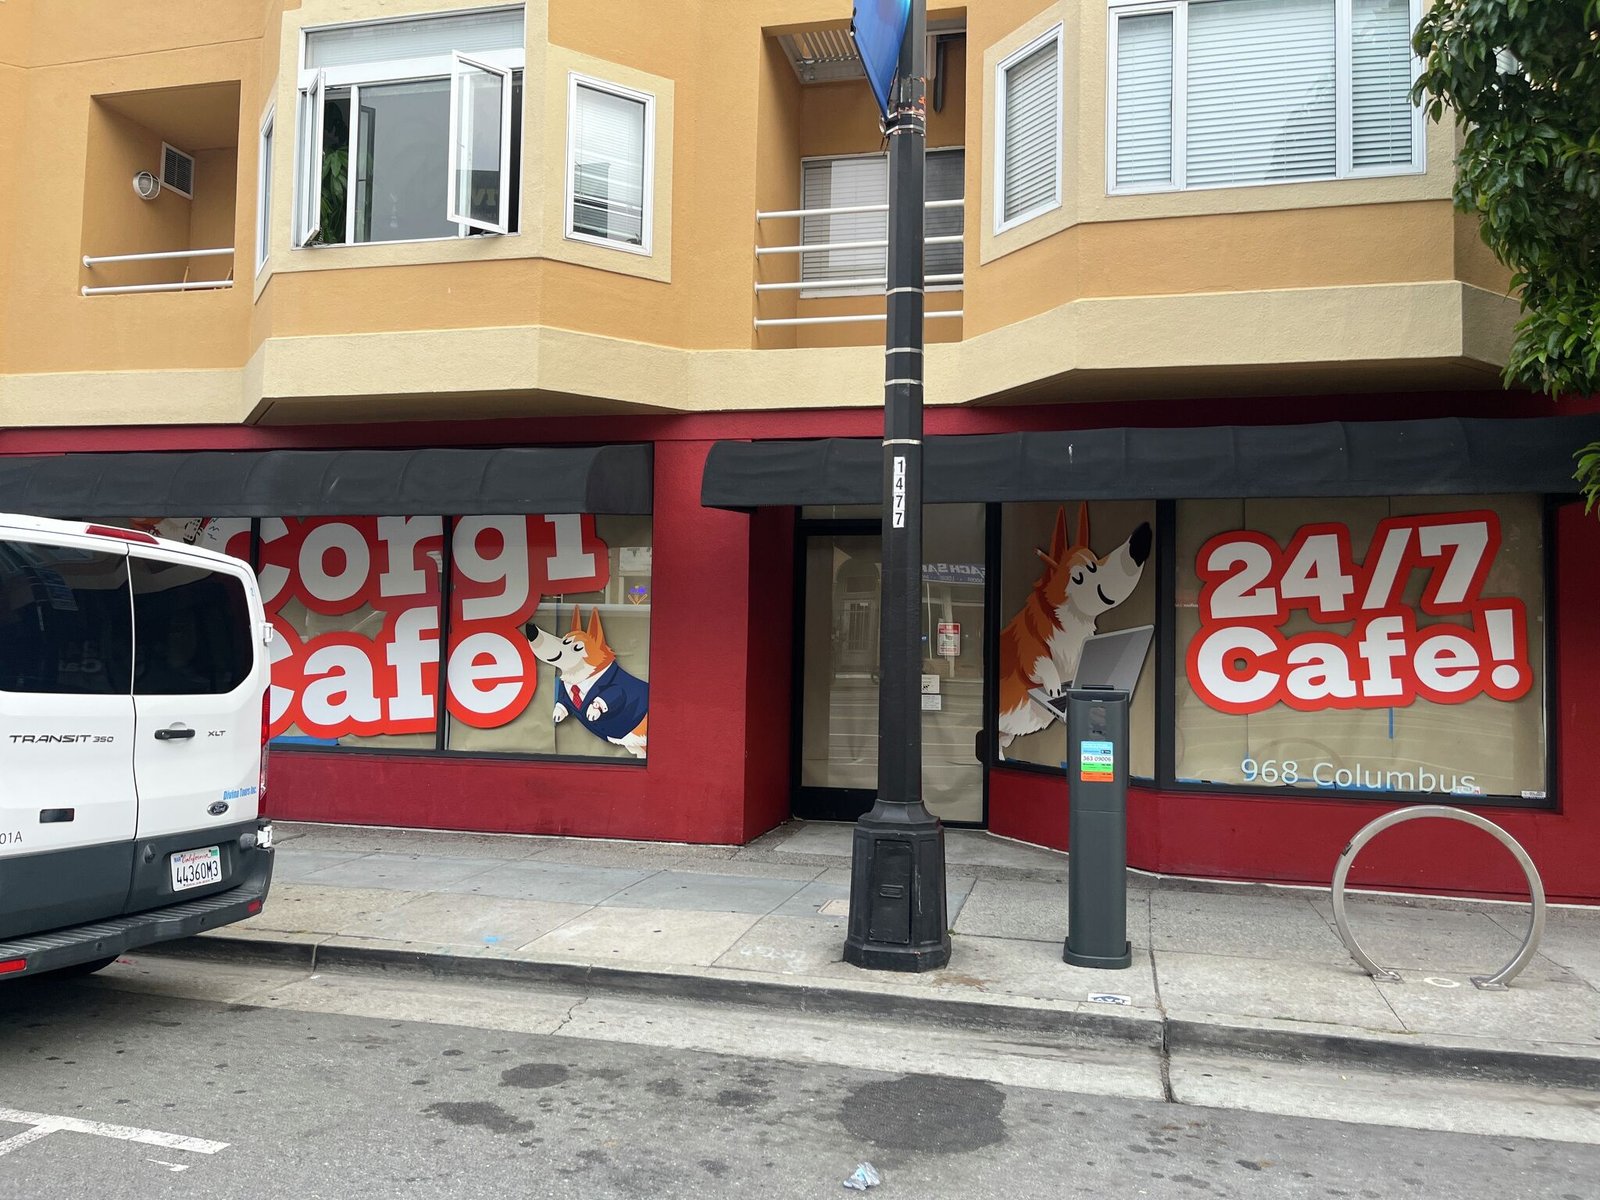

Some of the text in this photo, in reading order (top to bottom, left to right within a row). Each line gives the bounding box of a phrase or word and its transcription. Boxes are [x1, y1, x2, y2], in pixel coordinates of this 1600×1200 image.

[894, 459, 904, 526] 1477
[1207, 521, 1489, 619] 24/7
[1197, 609, 1520, 703] Cafe!
[9, 735, 91, 743] TRANSIT
[1241, 758, 1476, 794] 968 Columbus
[176, 860, 218, 884] 44360M3
[182, 853, 211, 864] California
